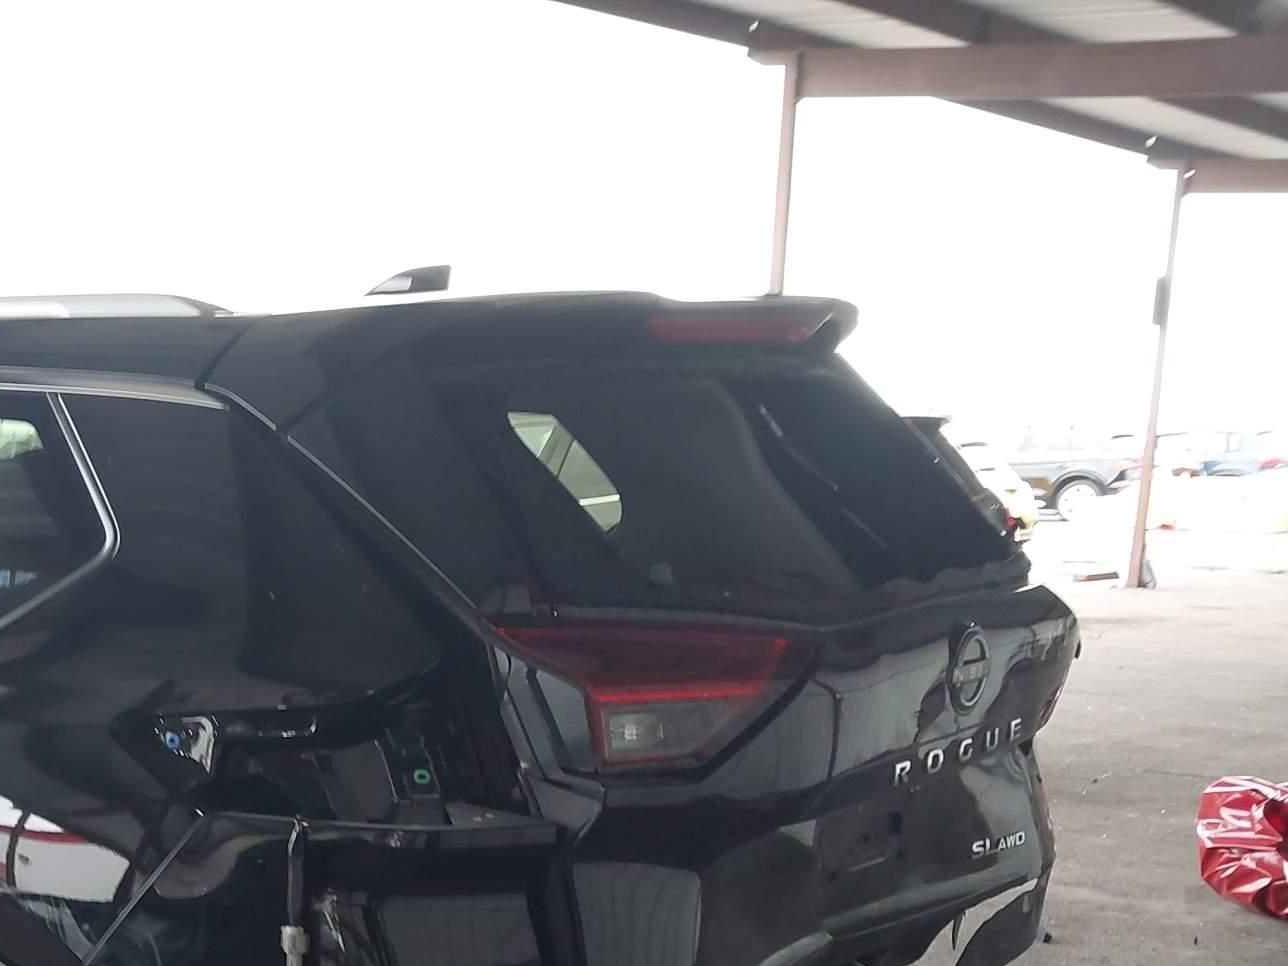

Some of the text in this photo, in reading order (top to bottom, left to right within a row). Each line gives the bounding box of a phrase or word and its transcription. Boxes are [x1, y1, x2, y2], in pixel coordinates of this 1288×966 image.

[894, 718, 1022, 785] ROGUE
[971, 831, 1026, 860] SL AWD
